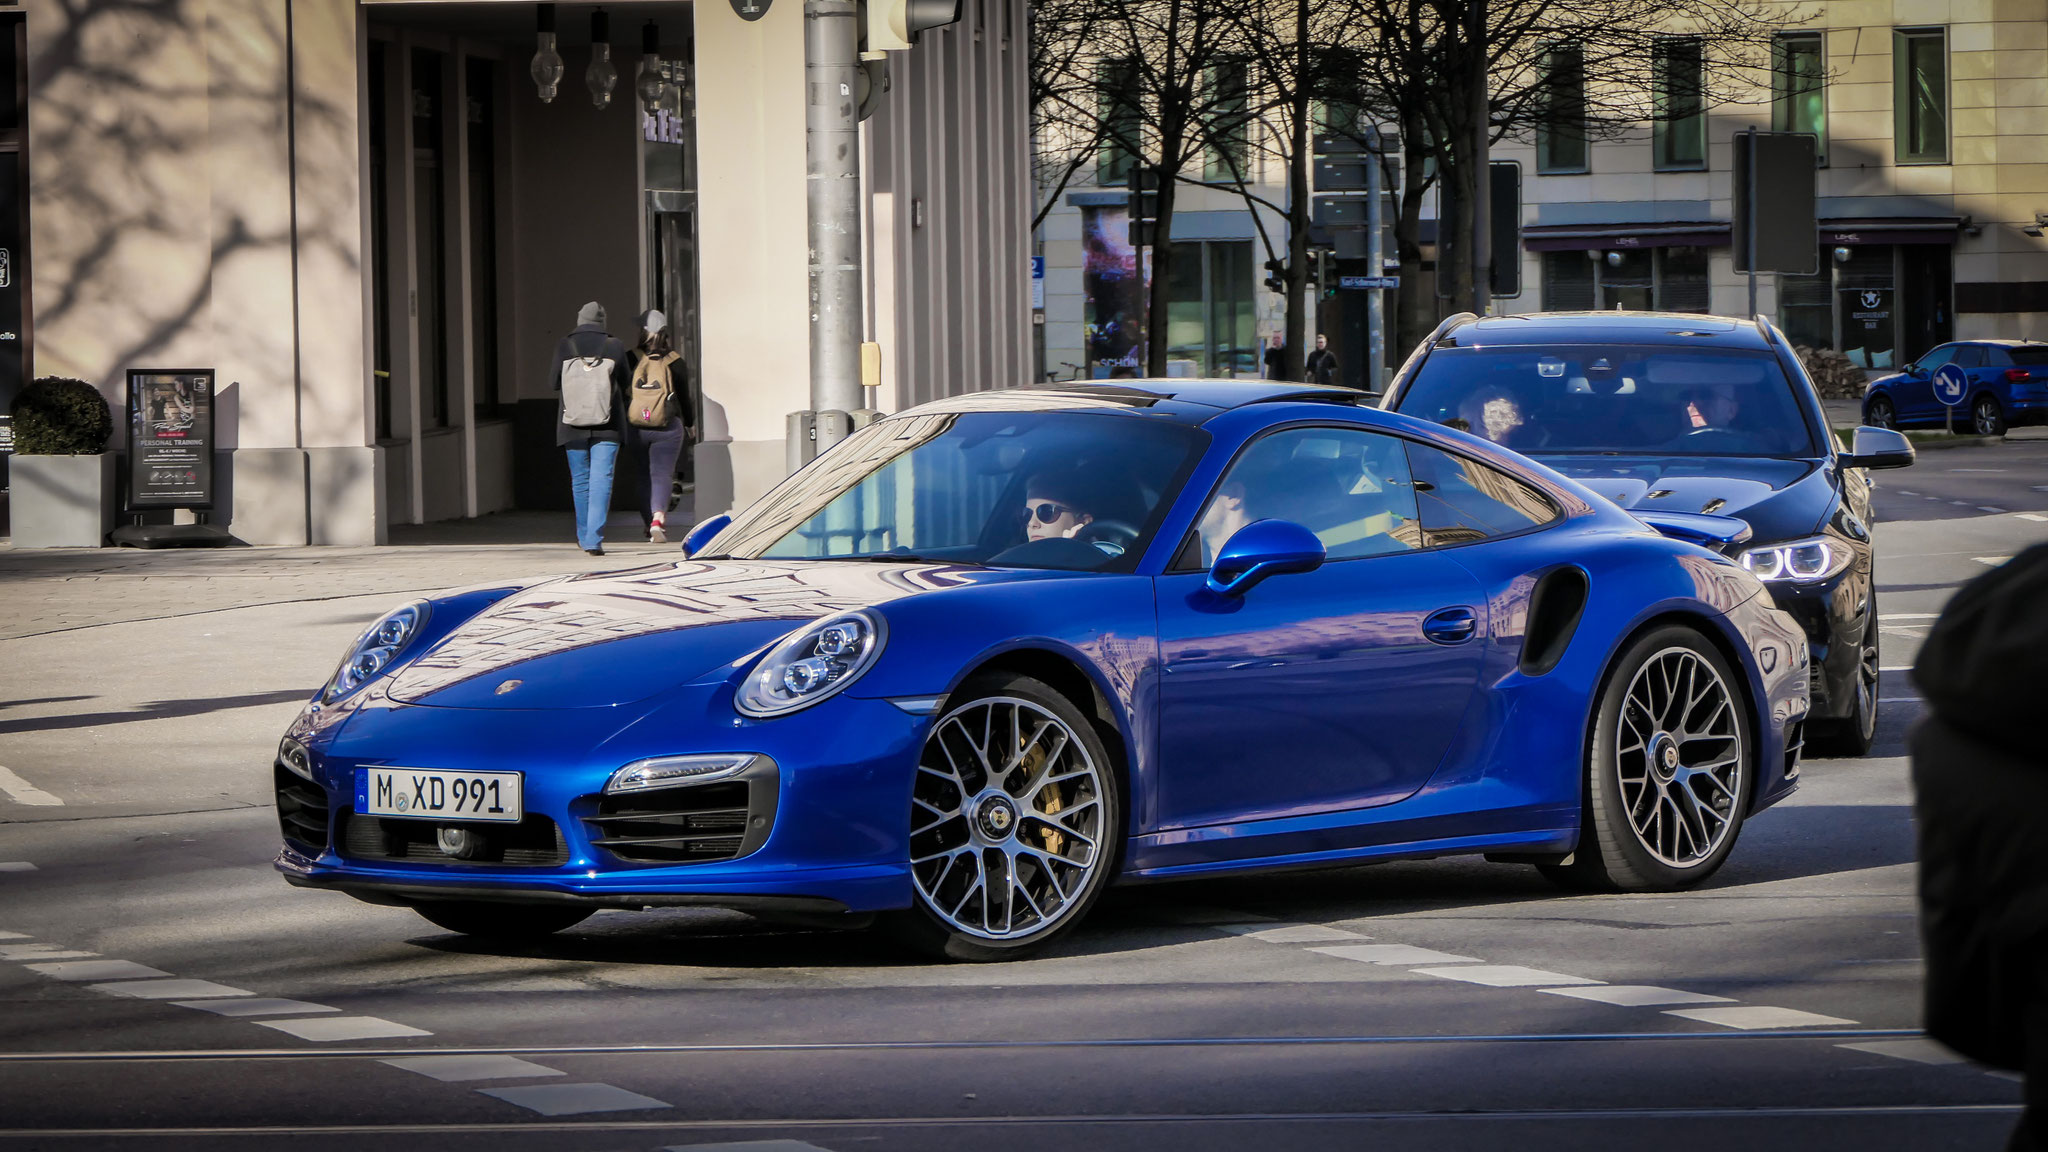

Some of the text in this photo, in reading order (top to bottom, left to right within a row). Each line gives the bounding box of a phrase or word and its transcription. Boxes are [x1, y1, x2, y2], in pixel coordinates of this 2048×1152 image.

[1100, 355, 1139, 367] SCHÖN
[377, 773, 504, 814] M XD 991
